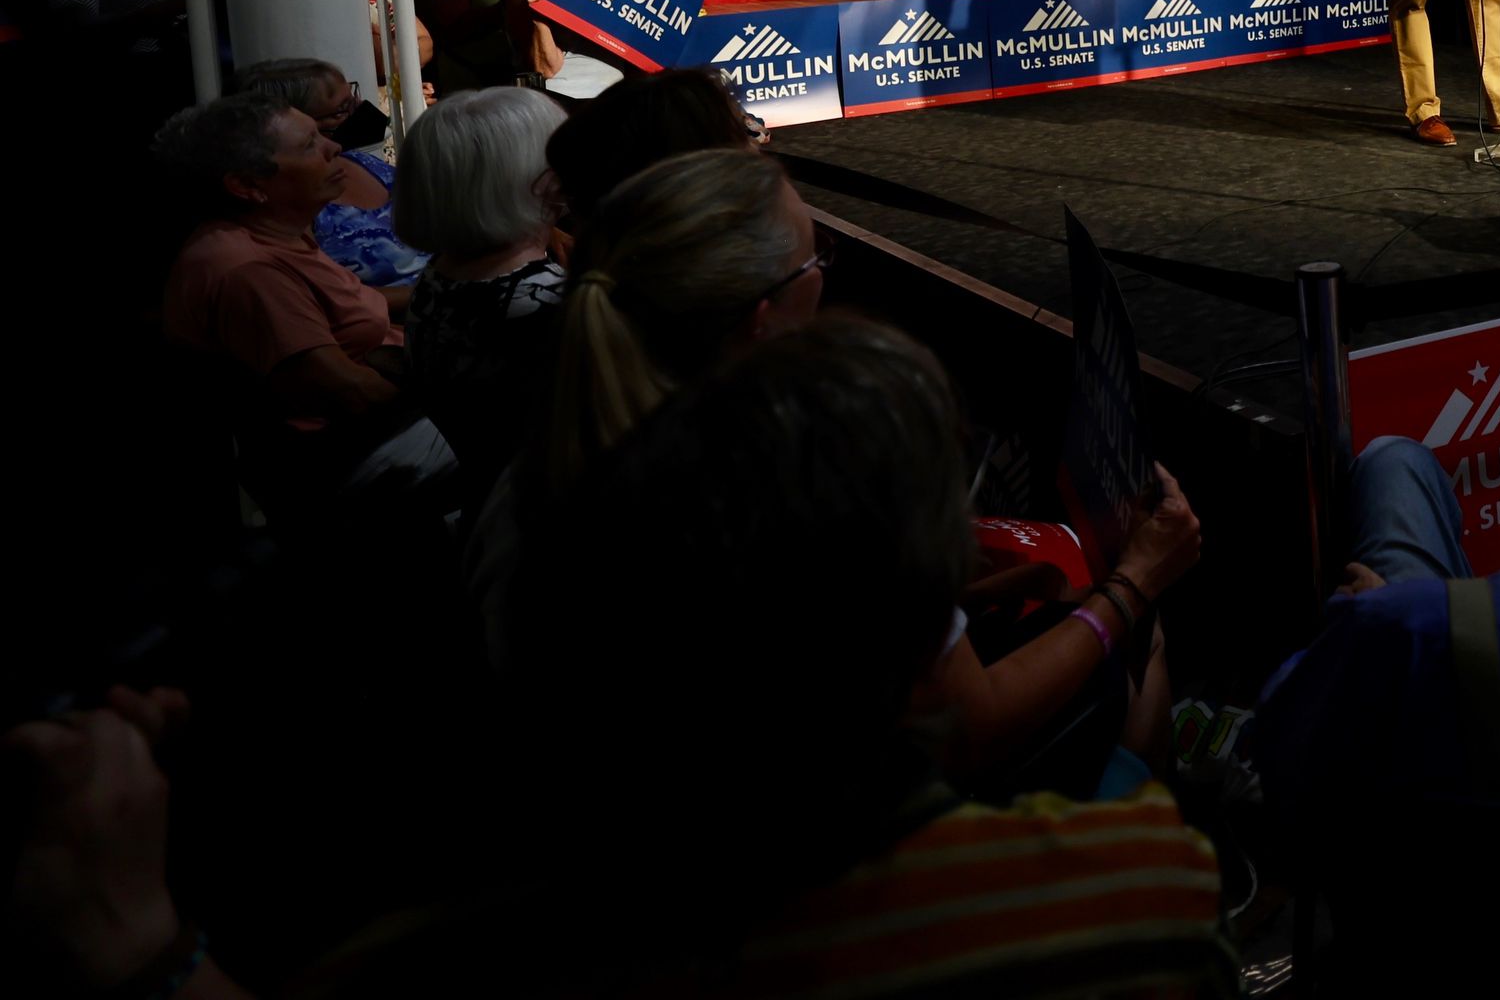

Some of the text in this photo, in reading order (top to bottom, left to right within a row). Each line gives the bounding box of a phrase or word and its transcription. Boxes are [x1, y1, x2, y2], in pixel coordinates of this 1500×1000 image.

[618, 3, 664, 42] SENATE
[1230, 6, 1319, 30] McMULLIN
[1342, 14, 1389, 29] U.S. SENAT
[1122, 17, 1222, 43] McMULLIN
[1247, 25, 1303, 41] U.S. SENATE
[997, 29, 1114, 56] McMULLIN
[1142, 38, 1205, 55] U.S. SENATE
[848, 41, 984, 73] McMULLIN
[1021, 52, 1094, 69] U.S. SENATE
[720, 55, 833, 87] MULLIN
[875, 66, 961, 86] U.S. SENATE
[746, 82, 807, 102] SENATE
